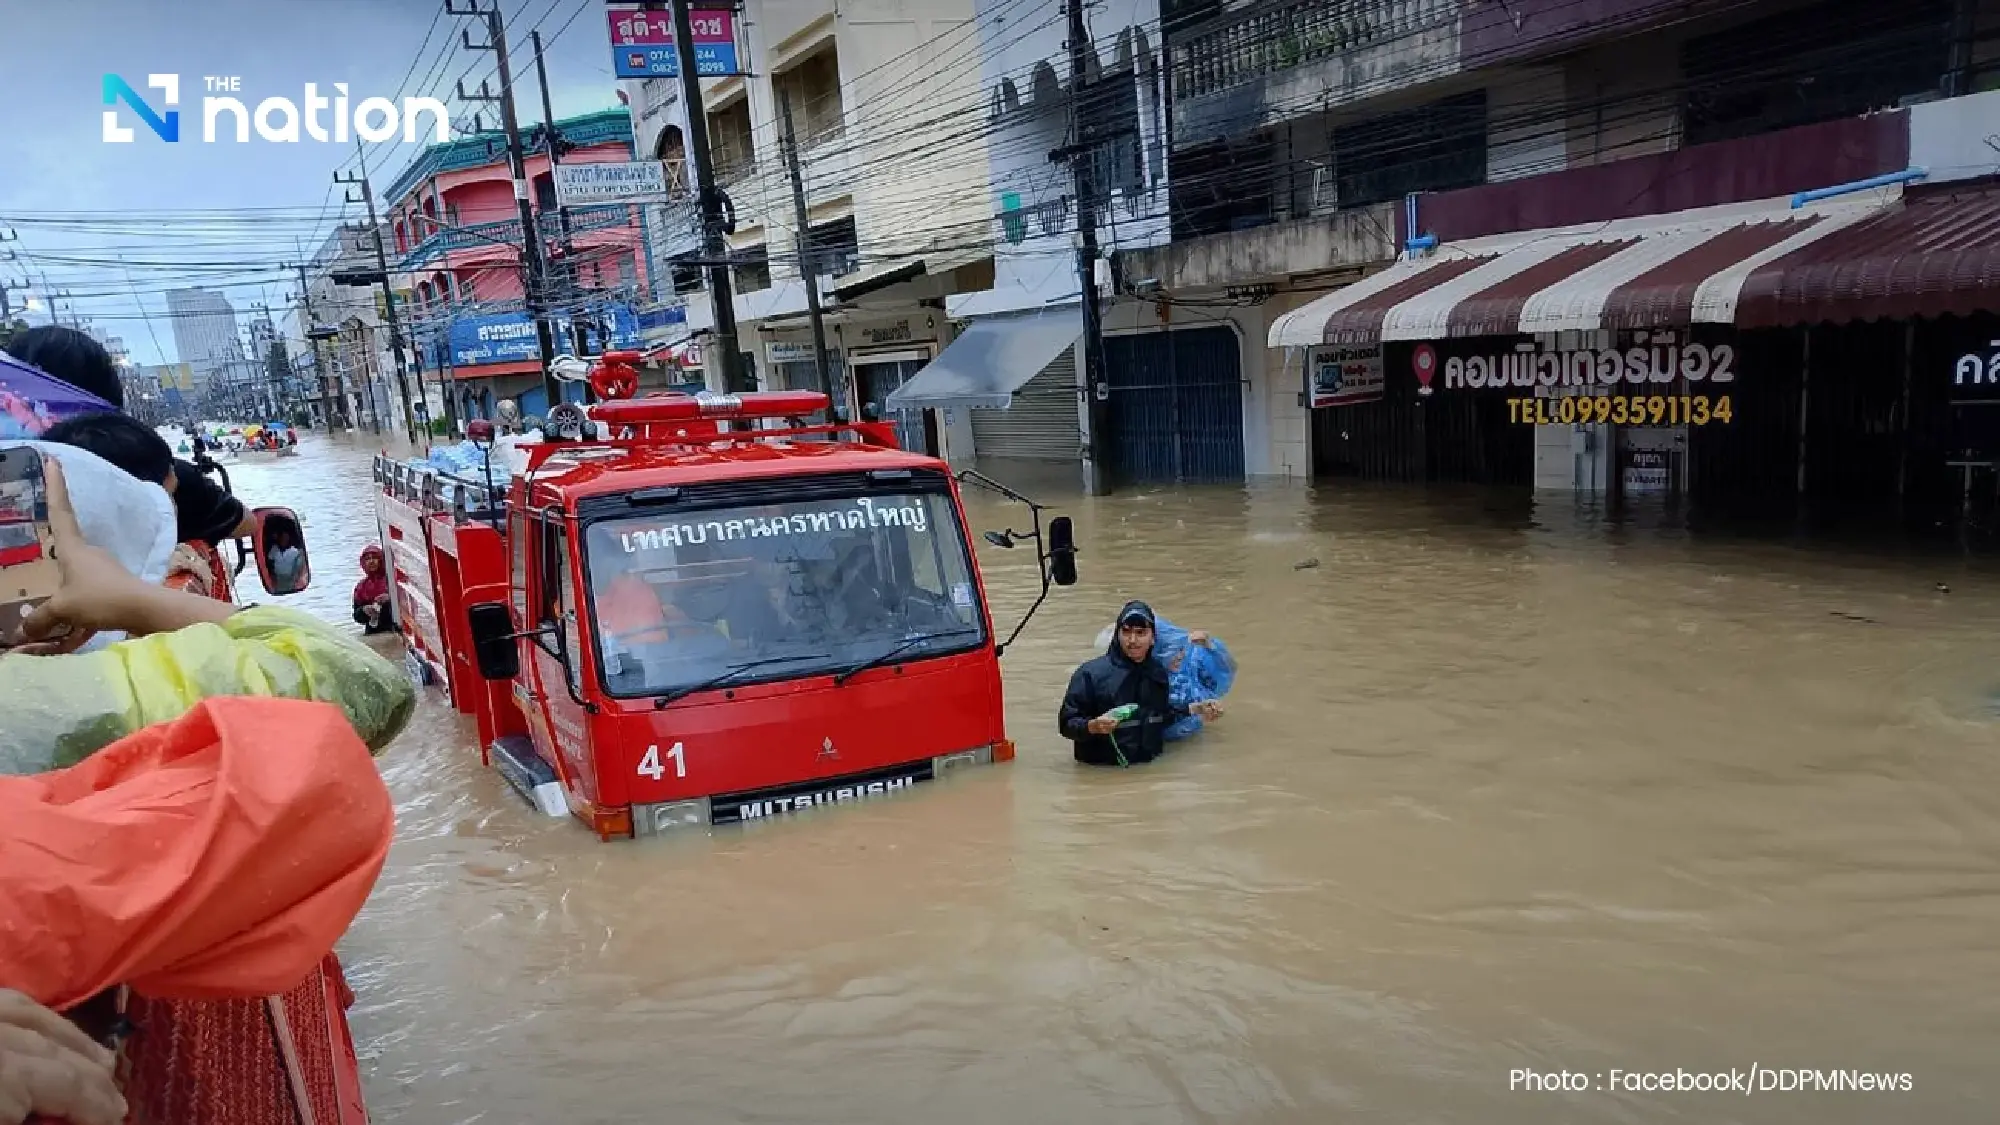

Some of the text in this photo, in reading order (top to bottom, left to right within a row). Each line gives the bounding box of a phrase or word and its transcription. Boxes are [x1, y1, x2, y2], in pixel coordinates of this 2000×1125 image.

[1445, 330, 1735, 389] คอมพิวเตอร์มือ2
[621, 497, 926, 553] เทศบาลนครหาดใหญ่
[637, 742, 686, 780] 41
